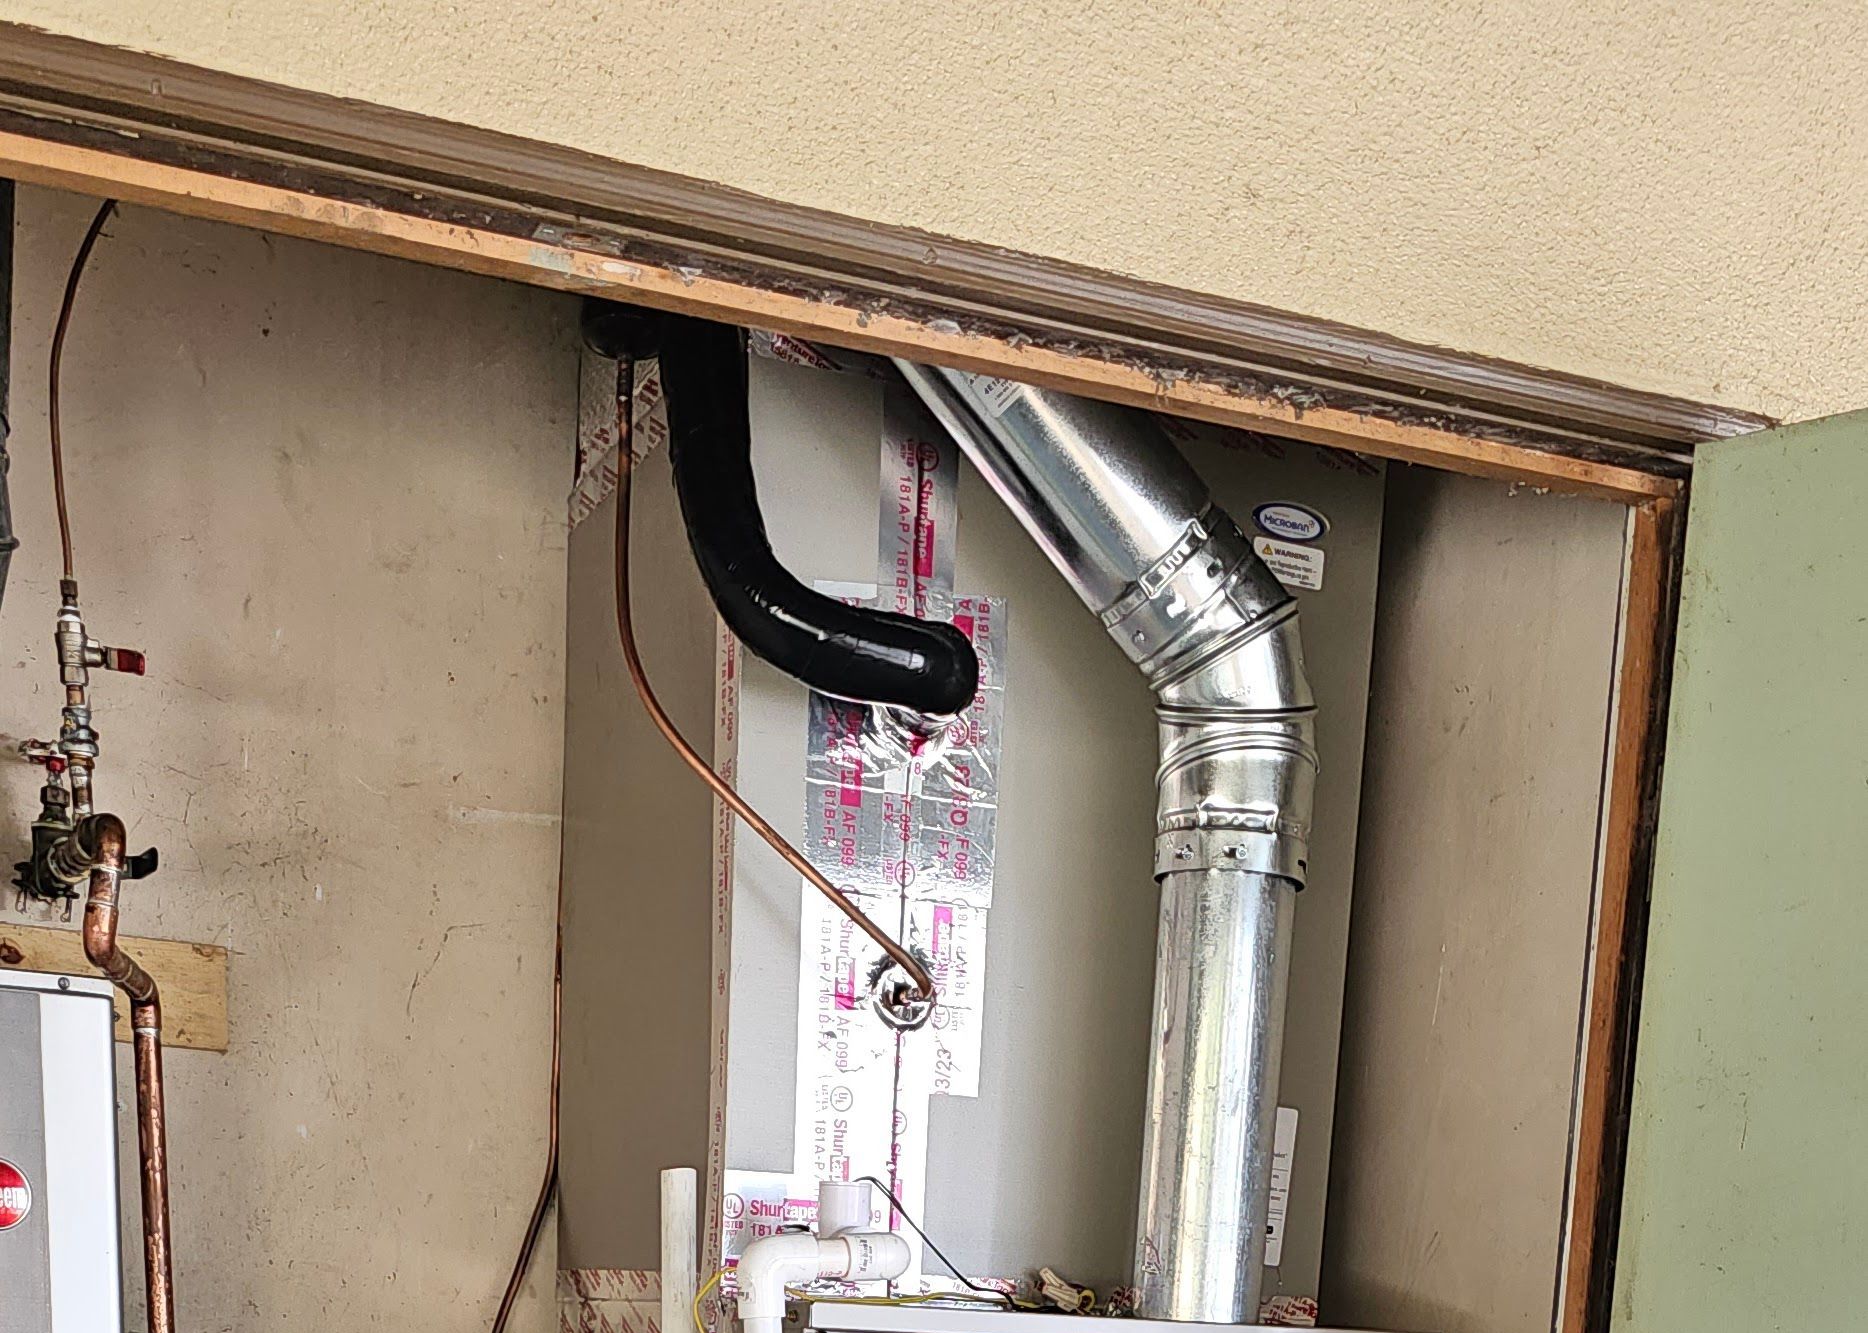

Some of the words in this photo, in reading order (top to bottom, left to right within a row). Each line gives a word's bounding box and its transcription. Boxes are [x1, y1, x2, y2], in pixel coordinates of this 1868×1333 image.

[898, 476, 914, 533] 181A-P
[841, 811, 856, 835] AF
[836, 1016, 851, 1038] AF
[834, 1040, 850, 1070] 099
